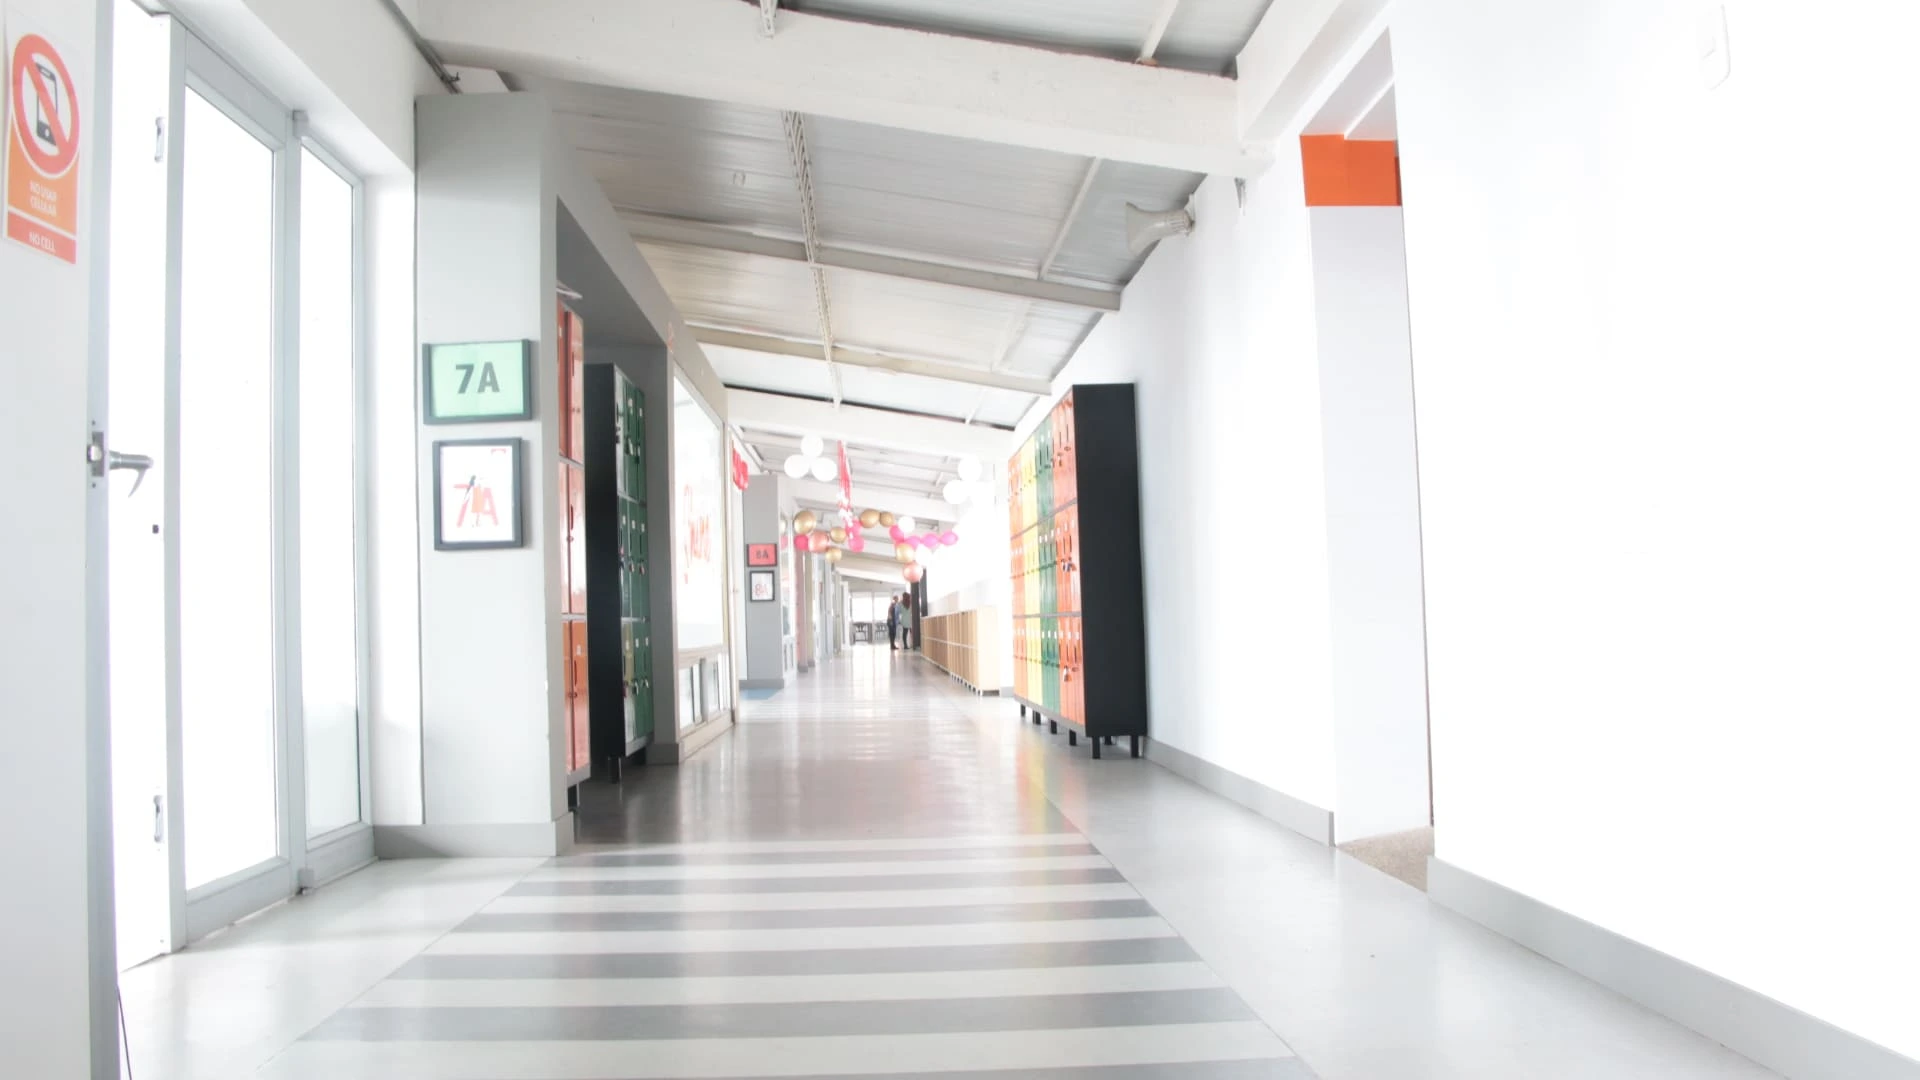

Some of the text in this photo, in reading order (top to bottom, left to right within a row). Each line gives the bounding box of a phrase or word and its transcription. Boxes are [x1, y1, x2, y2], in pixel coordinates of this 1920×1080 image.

[29, 232, 40, 246] NO
[455, 361, 500, 394] 7A
[454, 483, 500, 528] 7A
